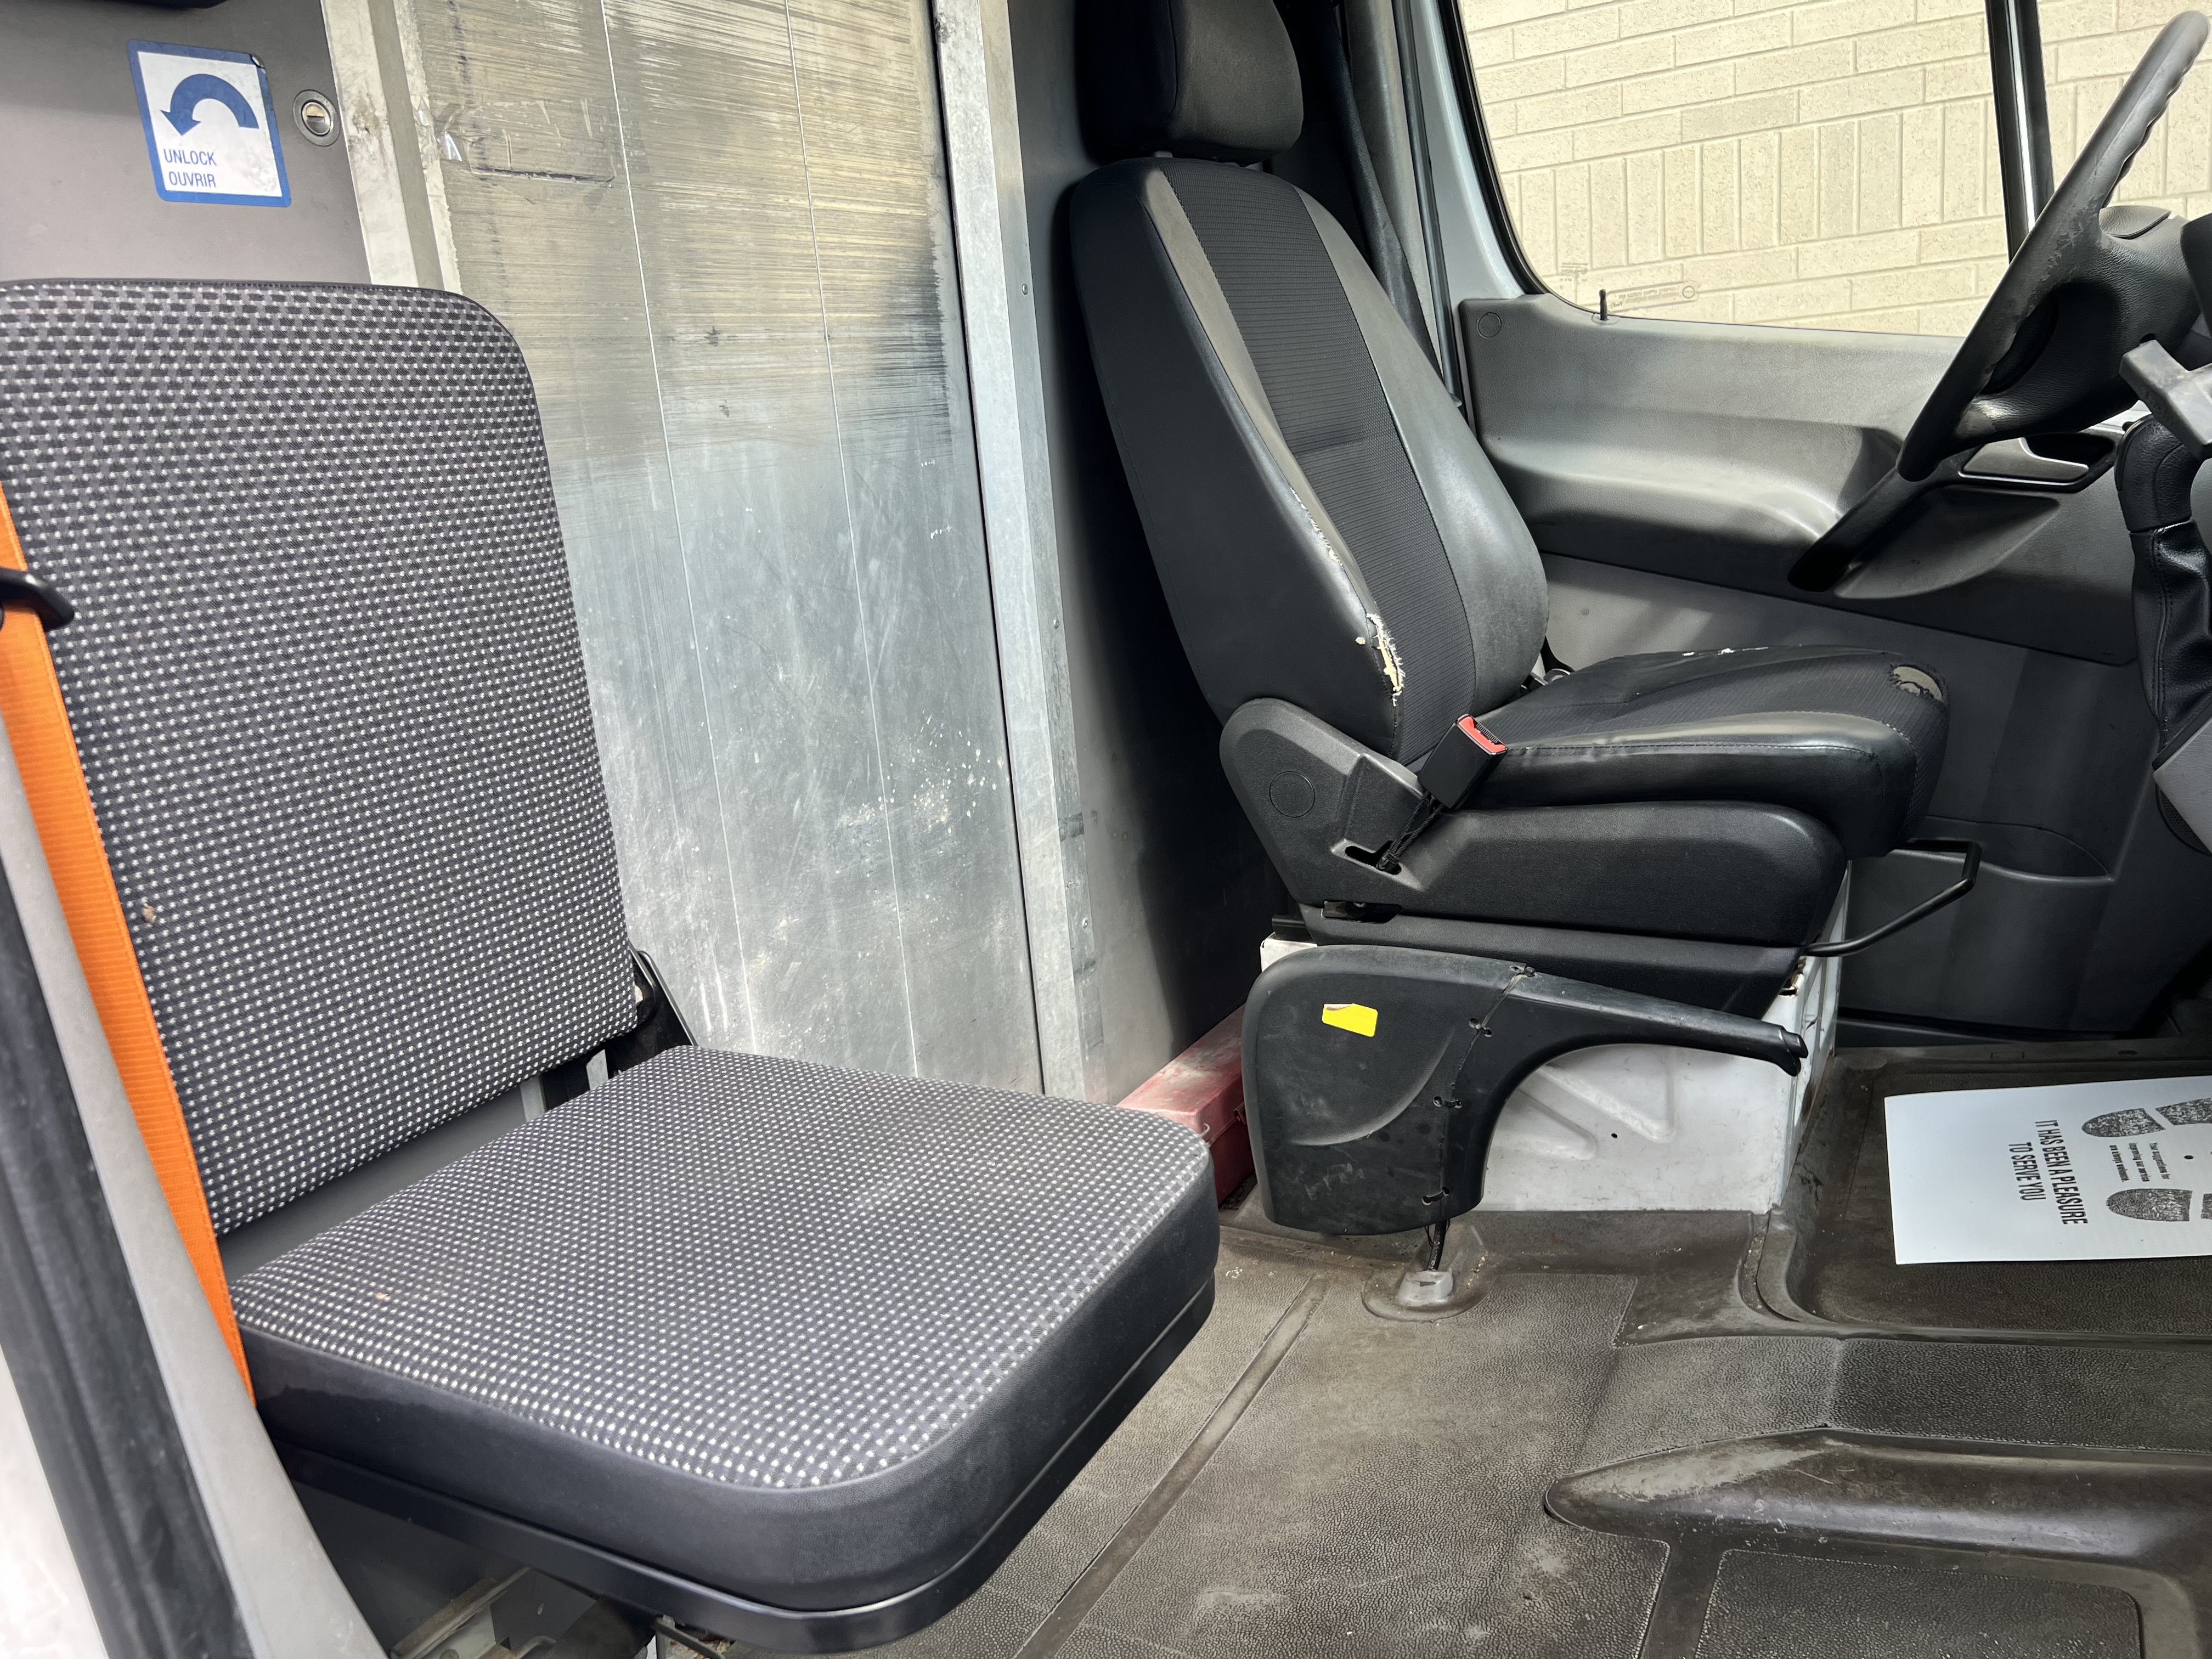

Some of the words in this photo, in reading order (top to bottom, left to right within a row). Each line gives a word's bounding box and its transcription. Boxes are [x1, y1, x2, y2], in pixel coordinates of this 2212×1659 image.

[163, 149, 217, 166] UNLOCK
[168, 171, 216, 188] OUVRIR
[2037, 1128, 2064, 1145] HAS
[2008, 1142, 2033, 1152] TO
[2042, 1146, 2071, 1167] BEEN
[2011, 1154, 2041, 1181] SERVE
[2018, 1182, 2046, 1200] YOU
[2051, 1176, 2089, 1224] PLEASURE
